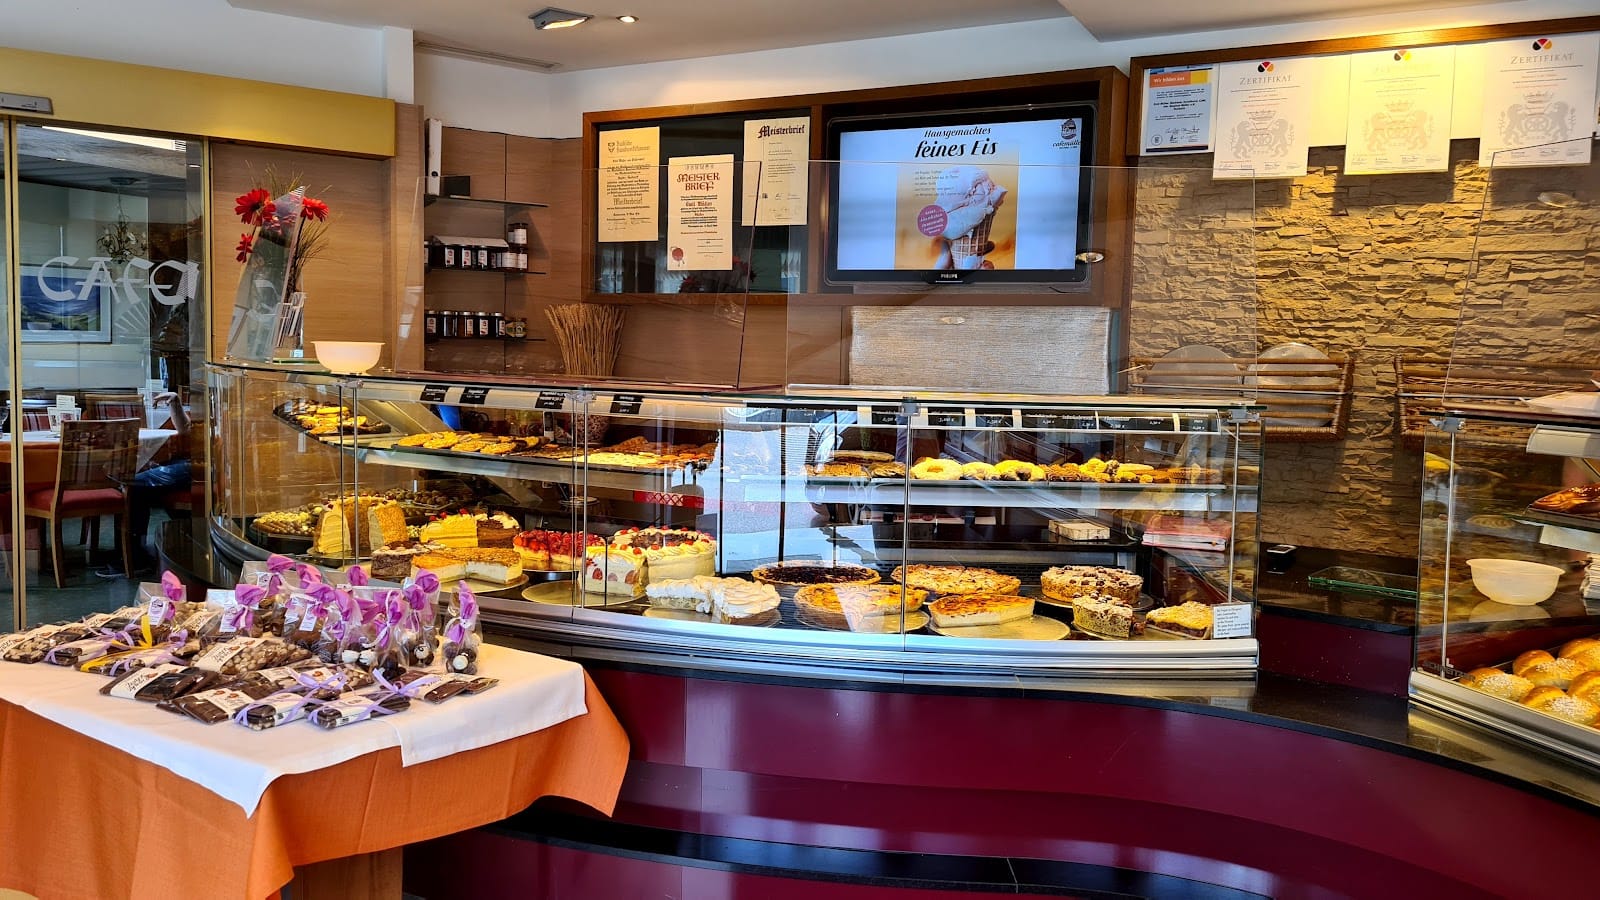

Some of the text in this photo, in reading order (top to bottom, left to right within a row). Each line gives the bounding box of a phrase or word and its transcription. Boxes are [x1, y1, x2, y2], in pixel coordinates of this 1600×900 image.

[1510, 53, 1574, 64] ZERTIFIKAT
[1239, 75, 1291, 85] ZERTIFIKAT
[758, 124, 805, 138] Meisterbrief
[924, 126, 992, 139] Hausgemachtes
[915, 137, 998, 158] feines Eis
